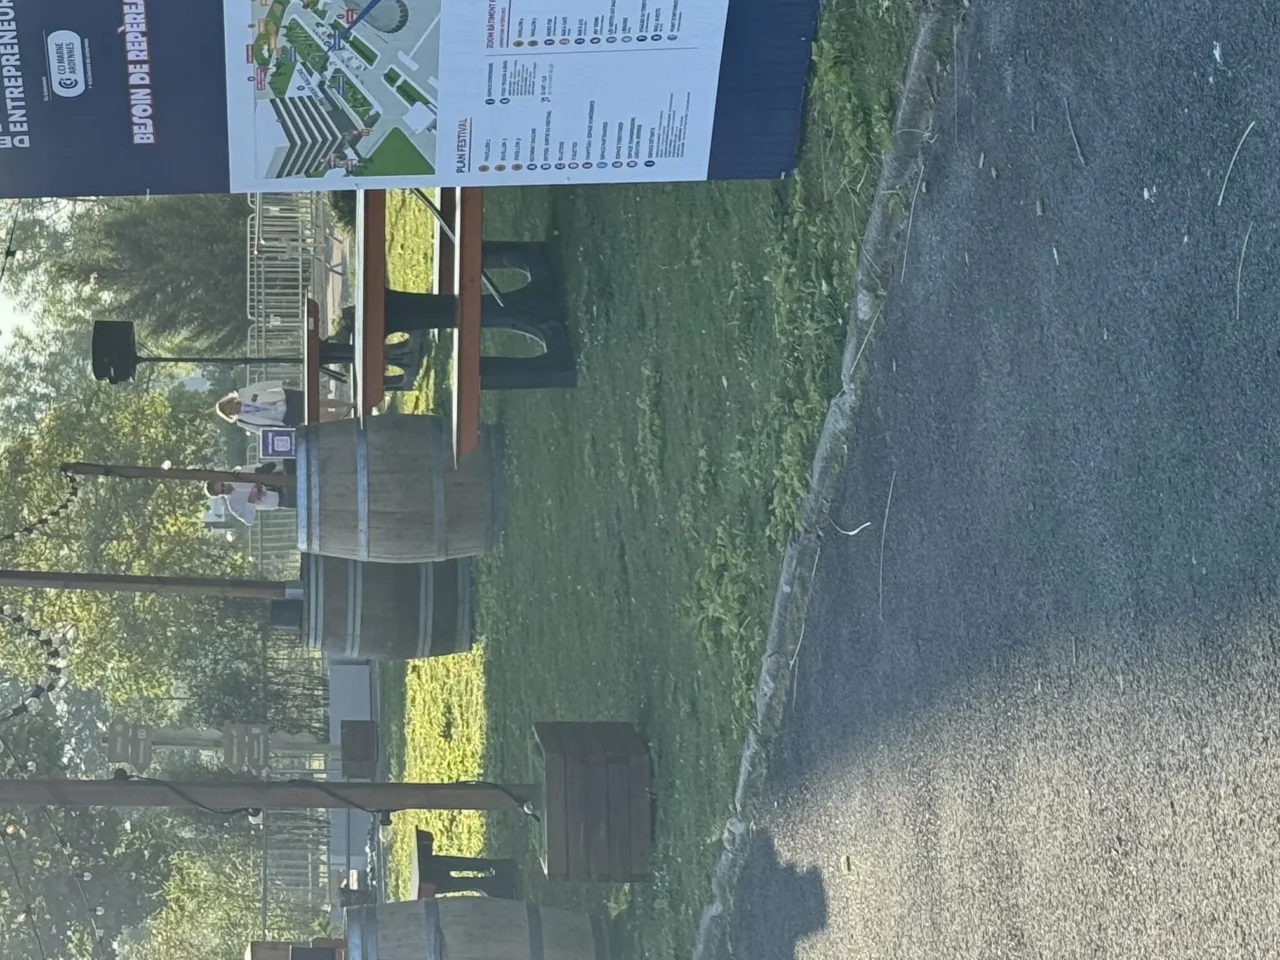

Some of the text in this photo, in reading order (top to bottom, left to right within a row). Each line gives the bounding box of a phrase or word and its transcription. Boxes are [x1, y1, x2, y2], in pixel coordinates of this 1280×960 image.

[486, 32, 494, 48] ZOOM
[54, 42, 66, 75] CCI MARNE
[65, 42, 76, 75] ARDENNES
[128, 64, 150, 84] DE
[131, 88, 154, 144] BESOIN
[456, 118, 468, 173] PLAN FESTIVAL
